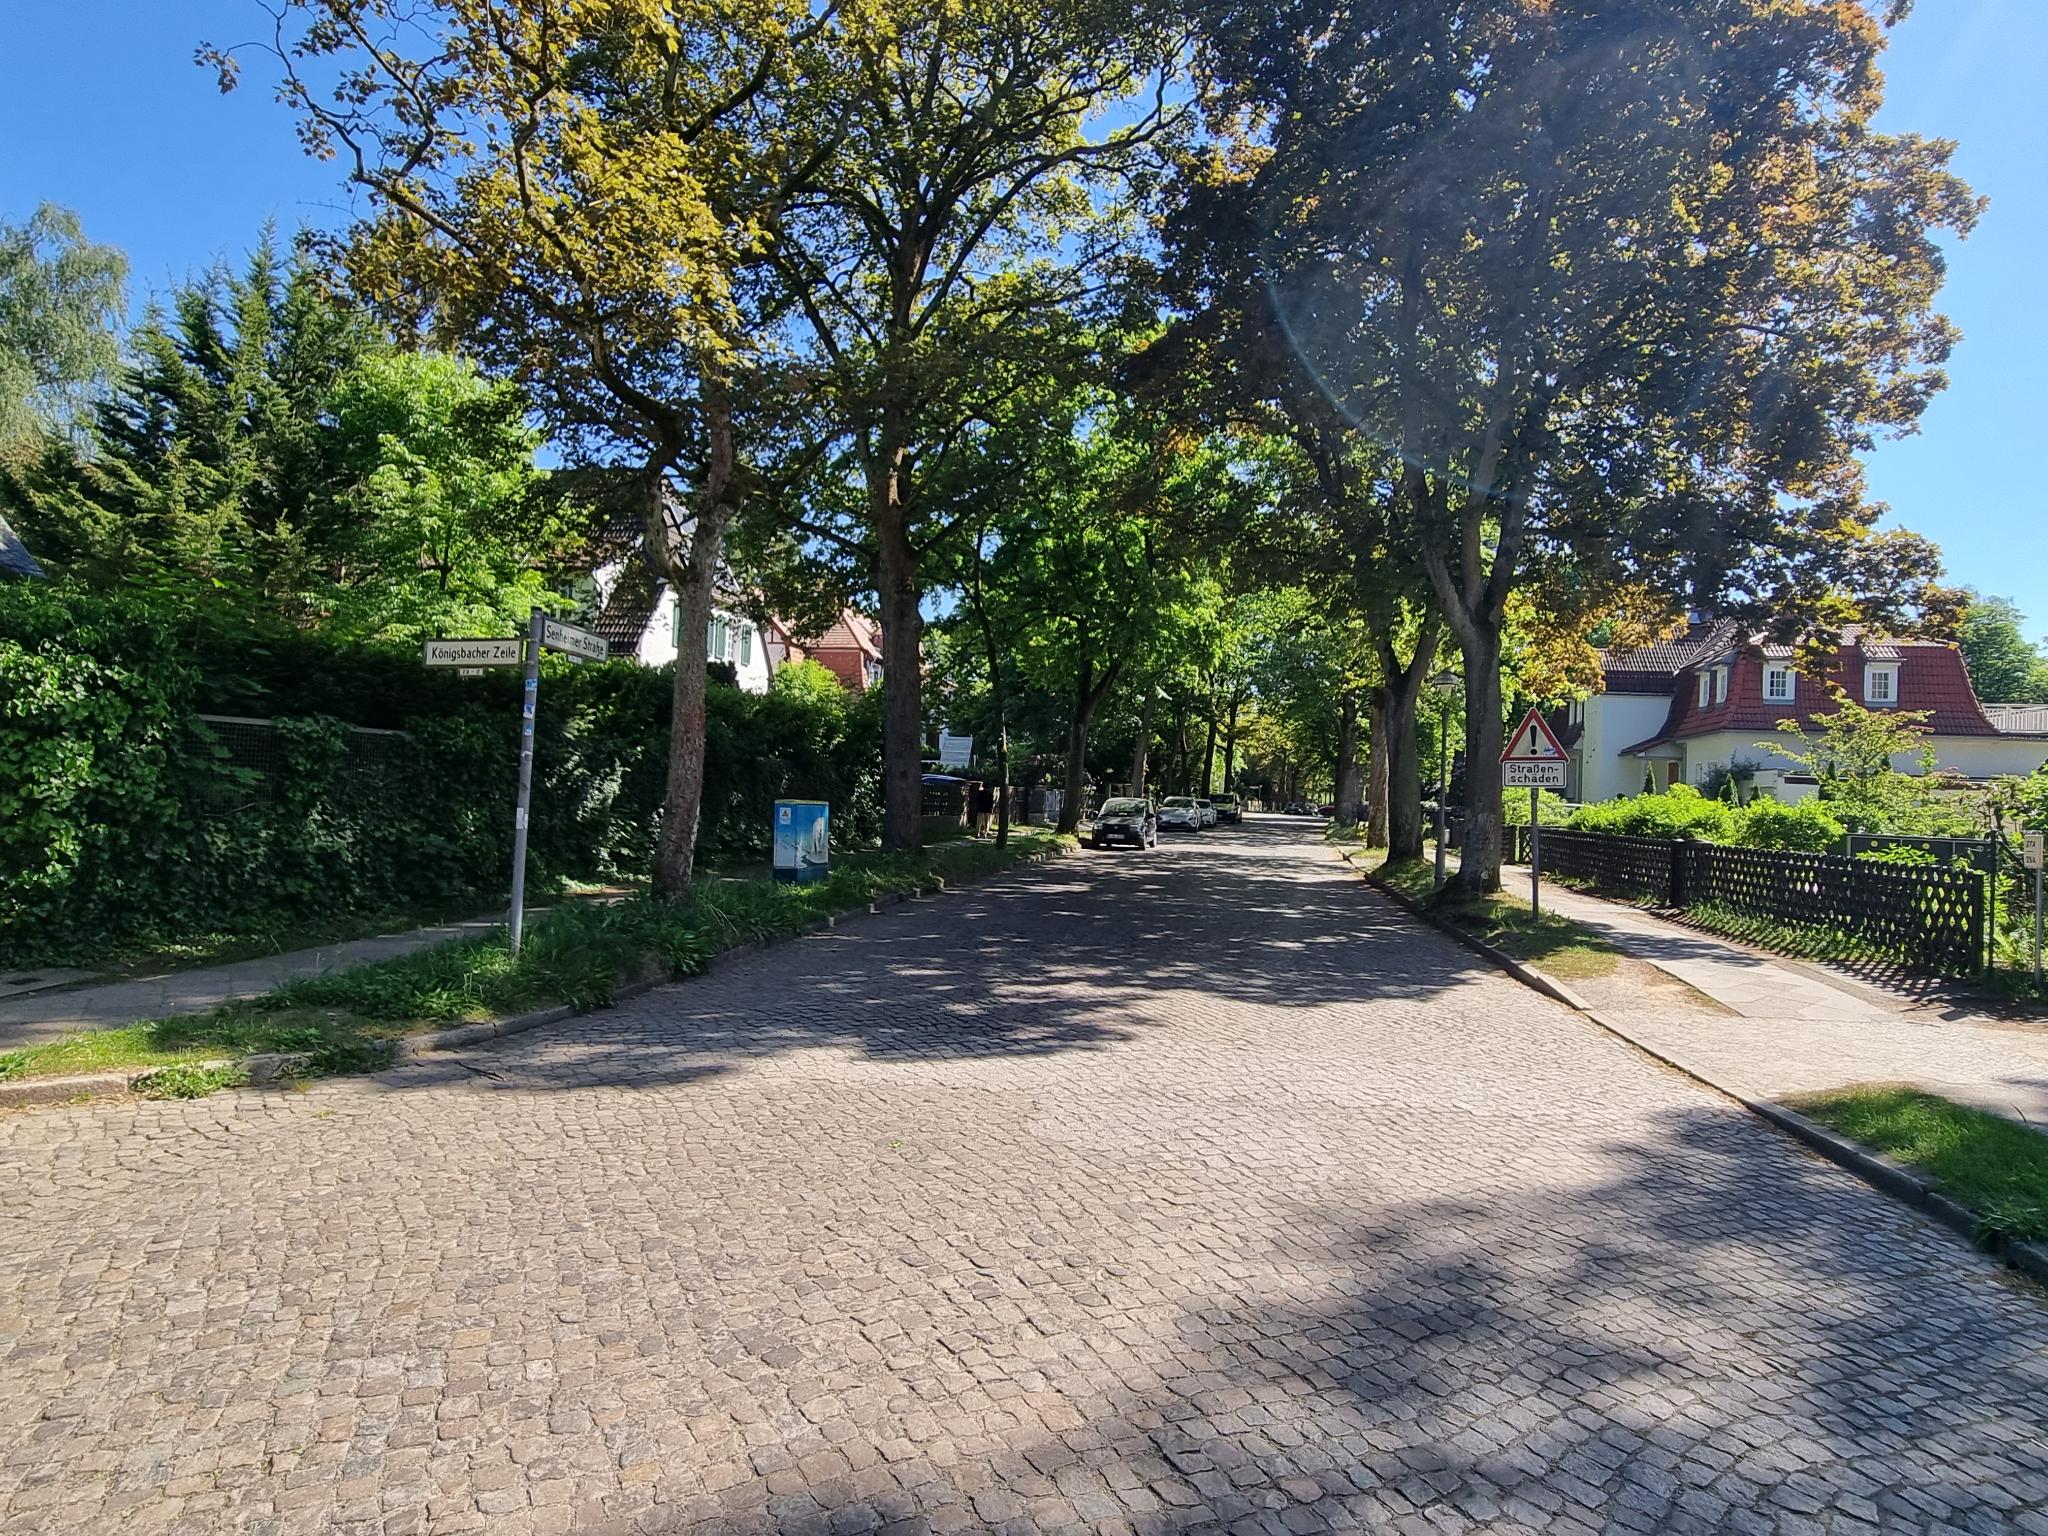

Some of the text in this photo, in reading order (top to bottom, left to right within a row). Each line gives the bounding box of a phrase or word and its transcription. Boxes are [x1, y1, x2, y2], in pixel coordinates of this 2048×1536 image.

[546, 625, 604, 657] Senheimer Straße
[431, 646, 516, 661] Königsbacher Zeile
[1509, 764, 1559, 774] Straßen-
[1510, 773, 1559, 783] schäden
